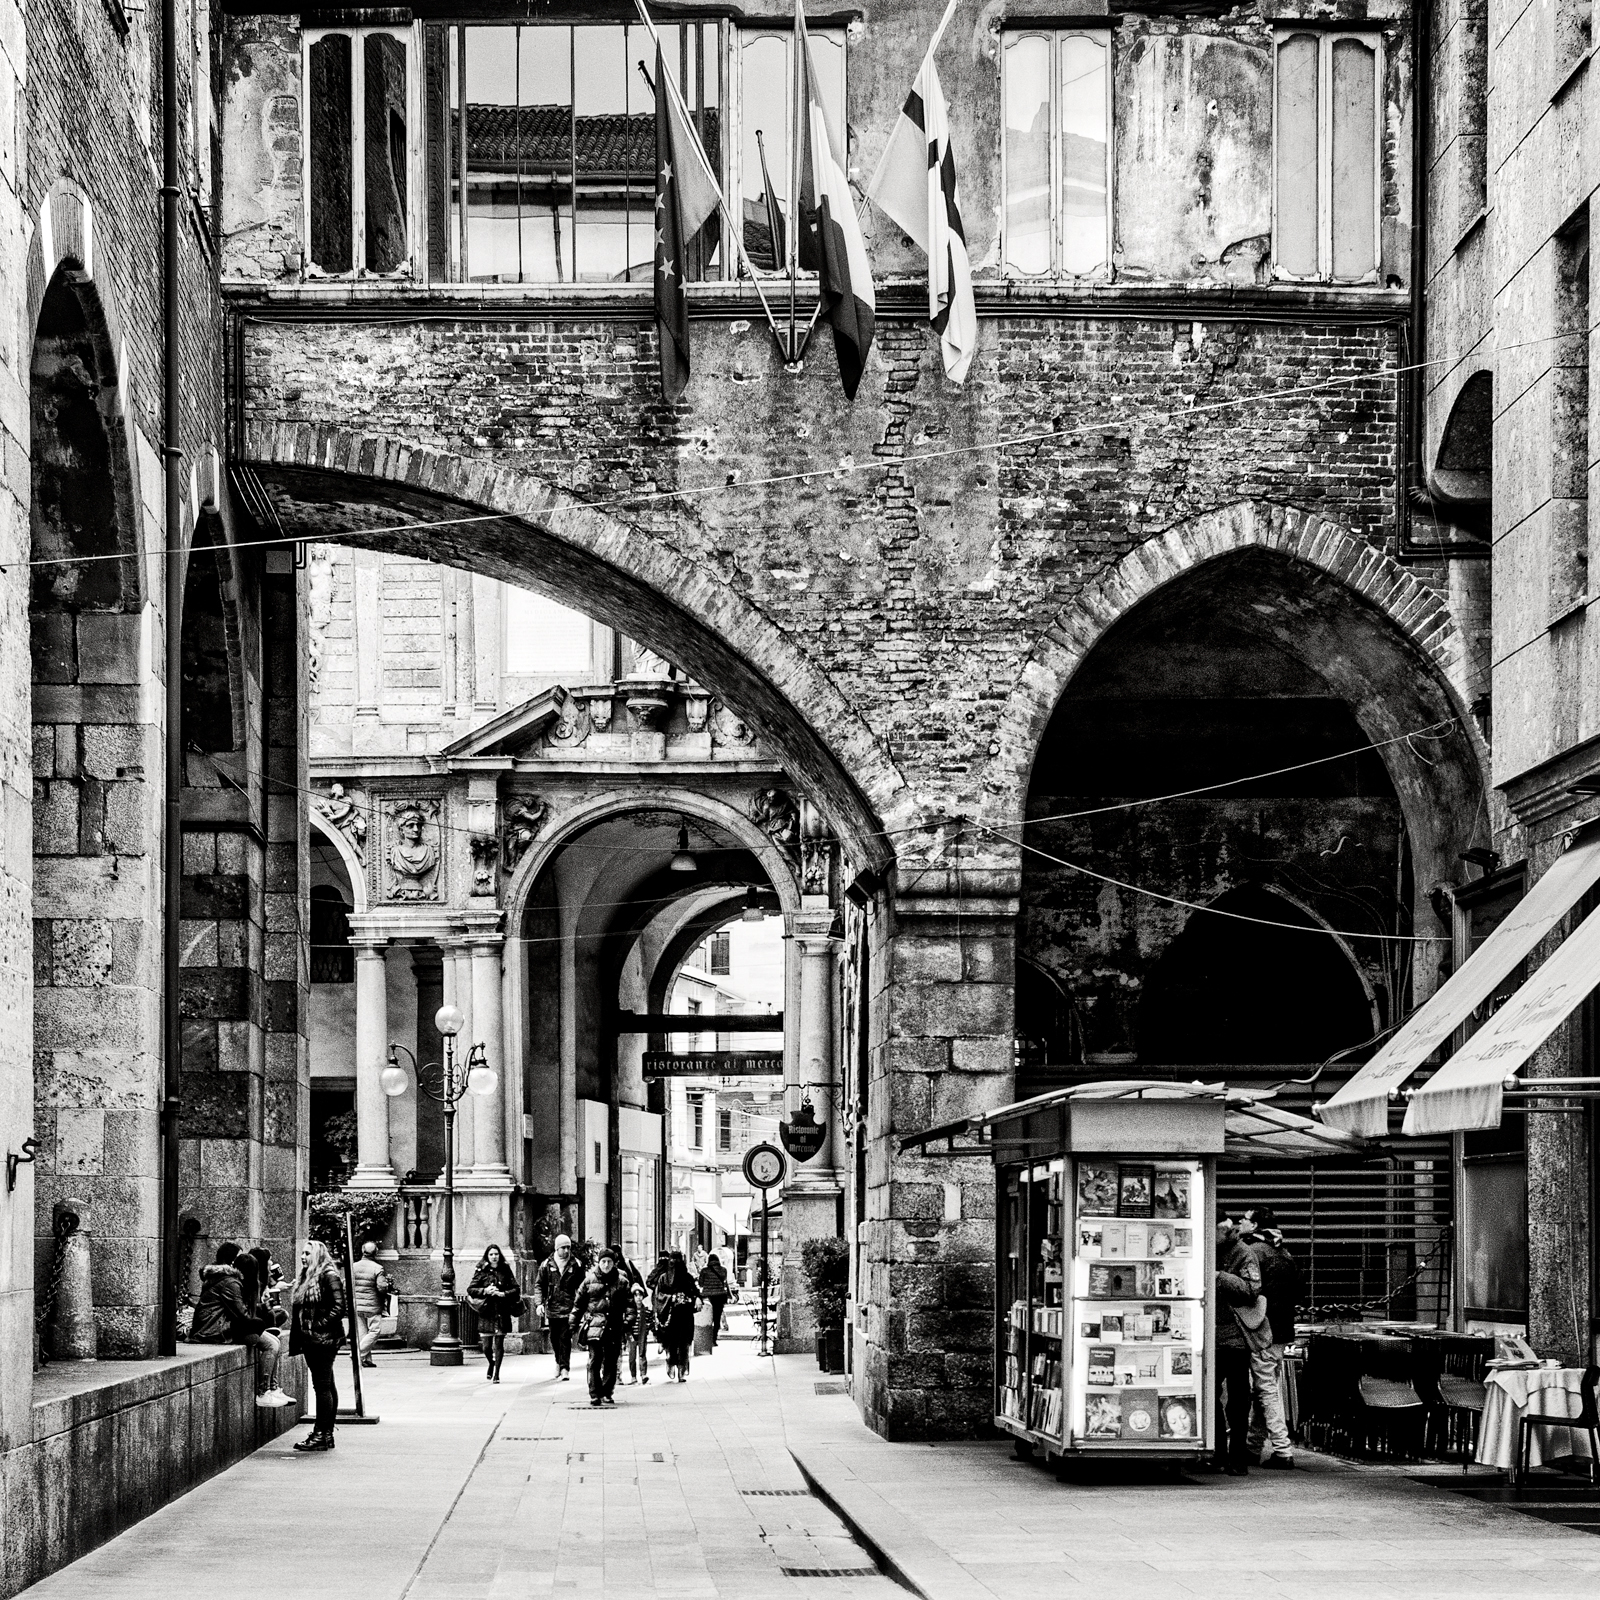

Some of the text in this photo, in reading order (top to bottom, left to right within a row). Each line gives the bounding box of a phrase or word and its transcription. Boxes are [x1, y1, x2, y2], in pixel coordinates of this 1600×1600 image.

[646, 1058, 717, 1070] ristorante
[788, 1125, 820, 1135] Ristorante
[789, 1144, 817, 1153] Mercante
